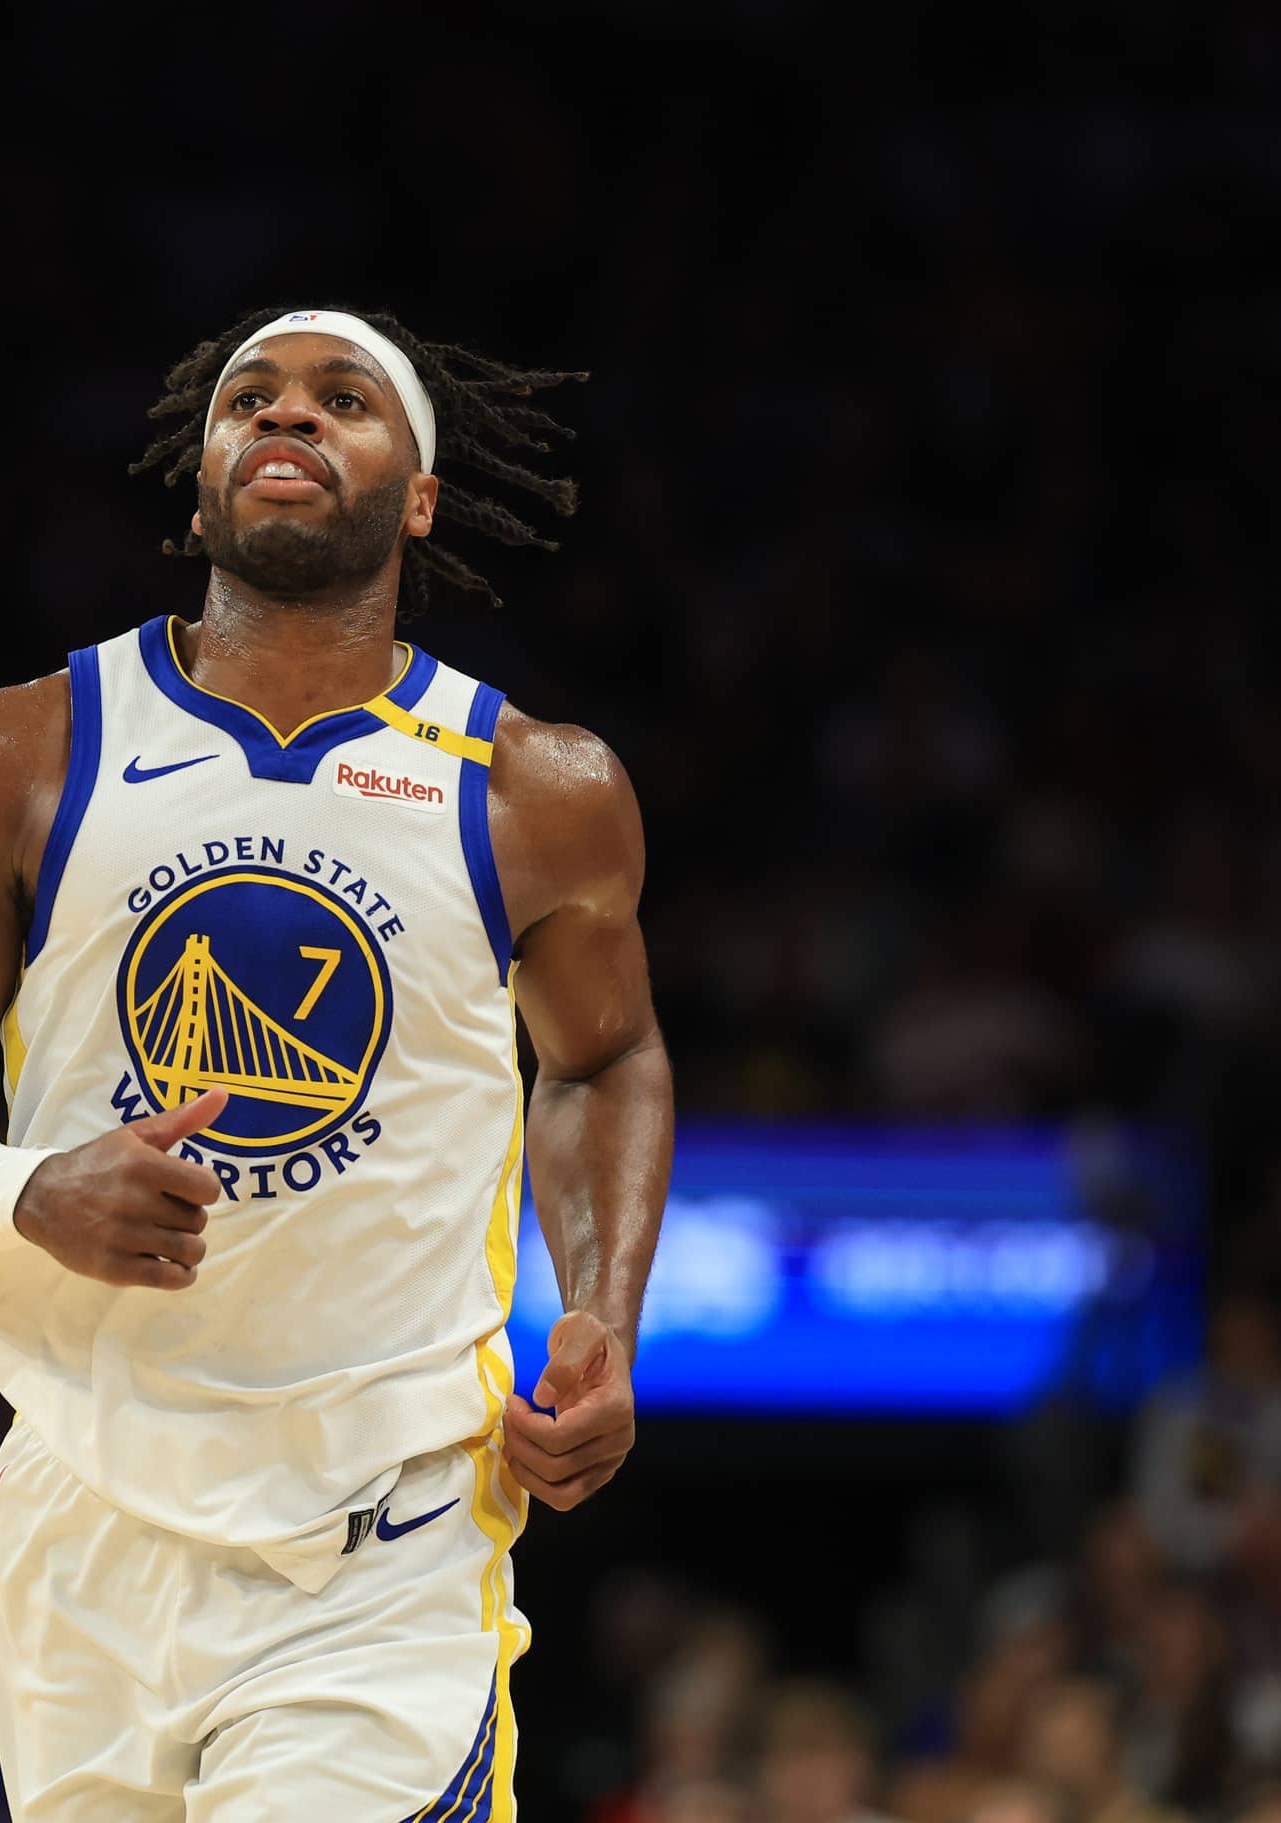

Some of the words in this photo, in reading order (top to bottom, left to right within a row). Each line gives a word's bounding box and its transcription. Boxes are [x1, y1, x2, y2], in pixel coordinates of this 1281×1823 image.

[413, 722, 441, 742] 16
[337, 762, 444, 804] Rakuten
[127, 836, 285, 914] GOLDEN
[303, 849, 406, 943] STATE
[293, 945, 342, 1020] 7
[110, 1071, 382, 1202] WRIORS
